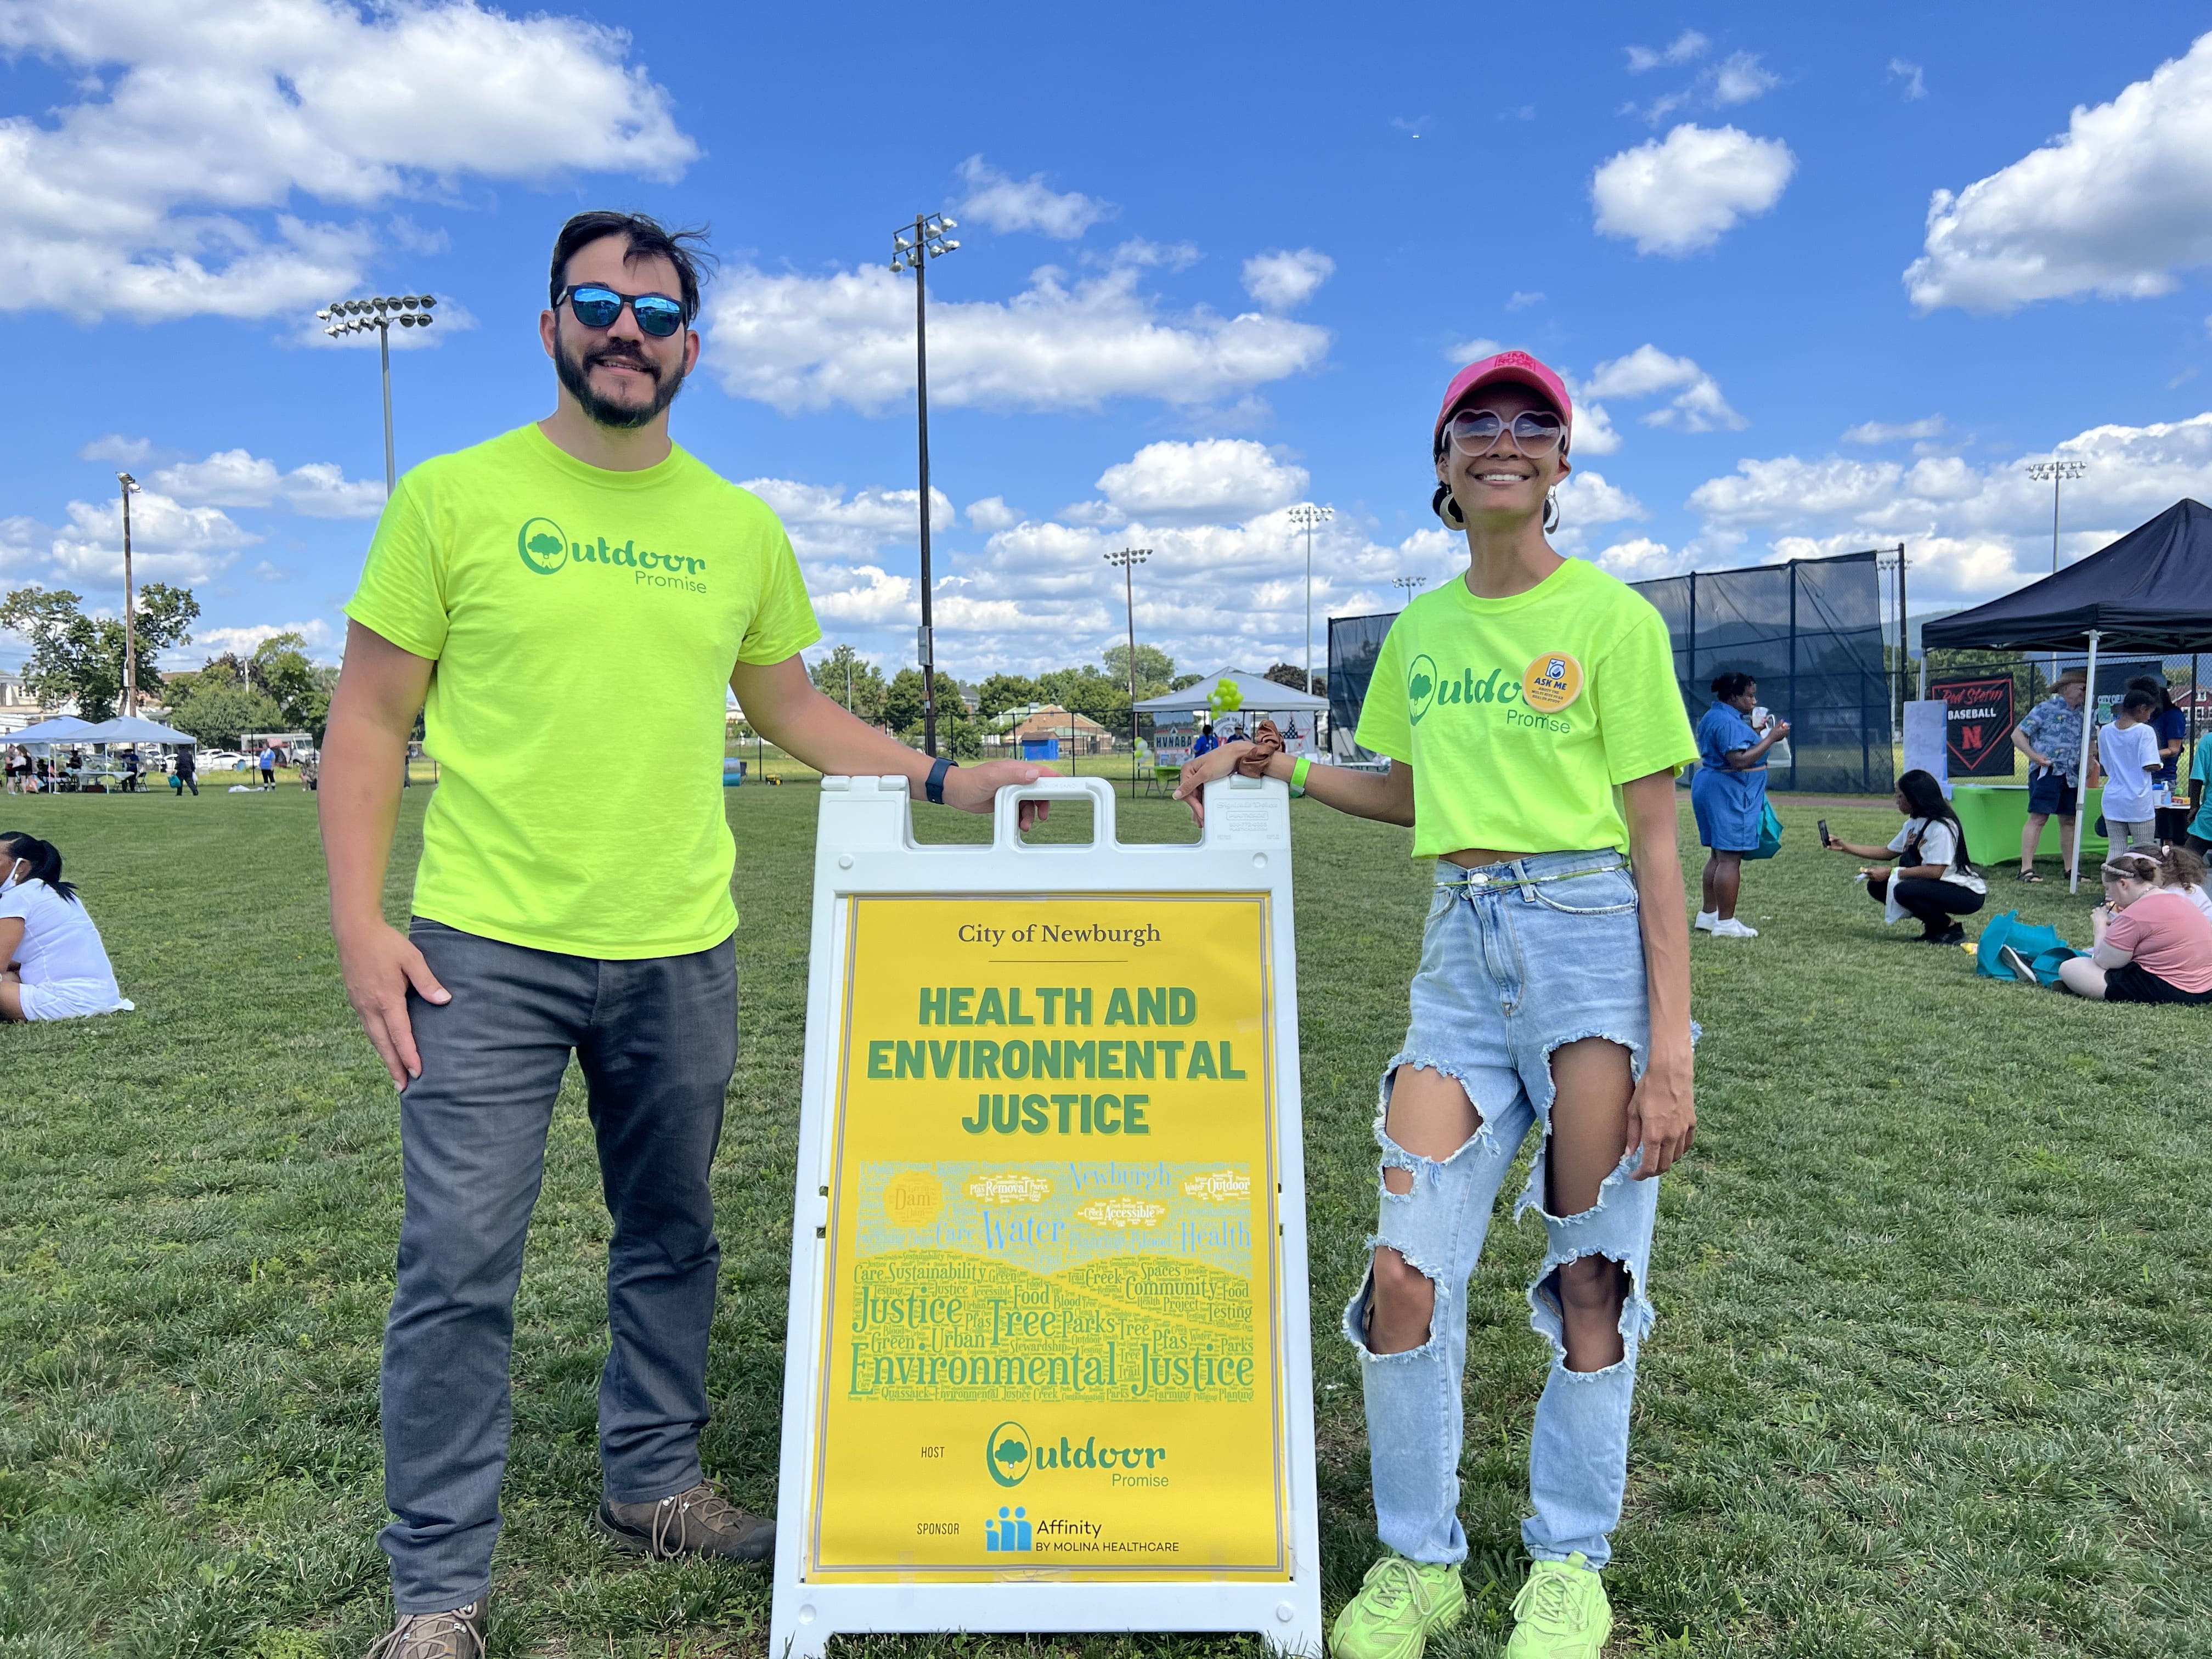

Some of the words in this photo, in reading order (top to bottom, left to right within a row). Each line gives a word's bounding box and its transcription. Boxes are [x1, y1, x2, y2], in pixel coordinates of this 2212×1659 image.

[518, 517, 706, 575] Outdoor
[635, 571, 707, 594] Promise
[1534, 678, 1552, 687] ASK
[1554, 681, 1567, 690] ME
[1506, 709, 1570, 734] Promise
[1948, 708, 1996, 720] BASEBALL
[1156, 736, 1192, 747] HVNABA
[1962, 725, 1982, 749] N
[958, 924, 1005, 946] City
[1012, 924, 1036, 942] of
[1041, 924, 1161, 946] Newburgh
[919, 987, 1093, 1026] HEALTH
[1104, 988, 1197, 1026] AND
[867, 1040, 1247, 1080] ENVIRONMENTAL
[962, 1094, 1150, 1135] JUSTICE
[1069, 1161, 1170, 1191] Newburgh
[986, 1181, 1028, 1196] Removal
[1207, 1176, 1250, 1193] Outdoor
[895, 1189, 930, 1210] Dam
[1104, 1205, 1155, 1221] Accessible
[936, 1221, 975, 1248] Care
[983, 1210, 1065, 1250] Water
[1181, 1221, 1251, 1252] Health
[902, 1251, 944, 1261] Sustainability
[854, 1264, 884, 1284] Care
[889, 1261, 986, 1283] Sustainability
[1096, 1263, 1108, 1272] Tree
[1141, 1262, 1180, 1280] Spaces
[989, 1269, 1017, 1283] Green
[1027, 1278, 1042, 1289] Food
[1068, 1272, 1084, 1283] Trail
[1086, 1268, 1122, 1287] Creek
[873, 1284, 902, 1299] Testing
[933, 1282, 968, 1297] Justice
[972, 1285, 1011, 1298] Accessible
[1098, 1286, 1121, 1294] Removal
[1126, 1276, 1217, 1300] Community
[1223, 1283, 1249, 1300] Food
[1014, 1284, 1049, 1309] Food
[1054, 1294, 1081, 1309] Blood
[1082, 1299, 1097, 1308] Tree
[1137, 1296, 1160, 1307] Health
[1163, 1297, 1198, 1312] Project
[852, 1286, 962, 1333] Justice
[964, 1300, 985, 1311] Urban
[1207, 1302, 1252, 1322] Testing
[966, 1313, 991, 1330] Pfas
[988, 1299, 1056, 1345] Tree
[1062, 1310, 1115, 1338] Parks
[1118, 1318, 1149, 1340] Tree
[883, 1325, 904, 1336] Blood
[1189, 1331, 1211, 1342] Water
[872, 1332, 915, 1353] Green
[932, 1327, 984, 1353] Urban
[1010, 1340, 1066, 1354] Stewardship
[1072, 1334, 1102, 1345] Outdoor
[1153, 1329, 1187, 1354] Pfas
[1221, 1338, 1253, 1355] Parks
[1120, 1348, 1140, 1362] Tree
[849, 1341, 1117, 1394] Environmental
[1118, 1364, 1140, 1378] Trail
[1131, 1343, 1254, 1396] Justice
[882, 1386, 929, 1401] Quassaick
[935, 1387, 998, 1400] Environmental
[1002, 1386, 1030, 1401] Justice
[1034, 1387, 1057, 1401] Creek
[1107, 1387, 1129, 1400] Parks
[1155, 1388, 1190, 1401] Farming
[1219, 1388, 1254, 1401] Planting
[921, 1446, 945, 1458] HOST
[986, 1421, 1166, 1488] Outdoor
[1112, 1474, 1169, 1487] Promise
[917, 1522, 960, 1535] SPONSOR
[1037, 1520, 1102, 1538] Affinity
[1036, 1542, 1051, 1551] BY
[1054, 1542, 1099, 1551] MOLINA
[1103, 1542, 1179, 1551] HEALTHCARE
